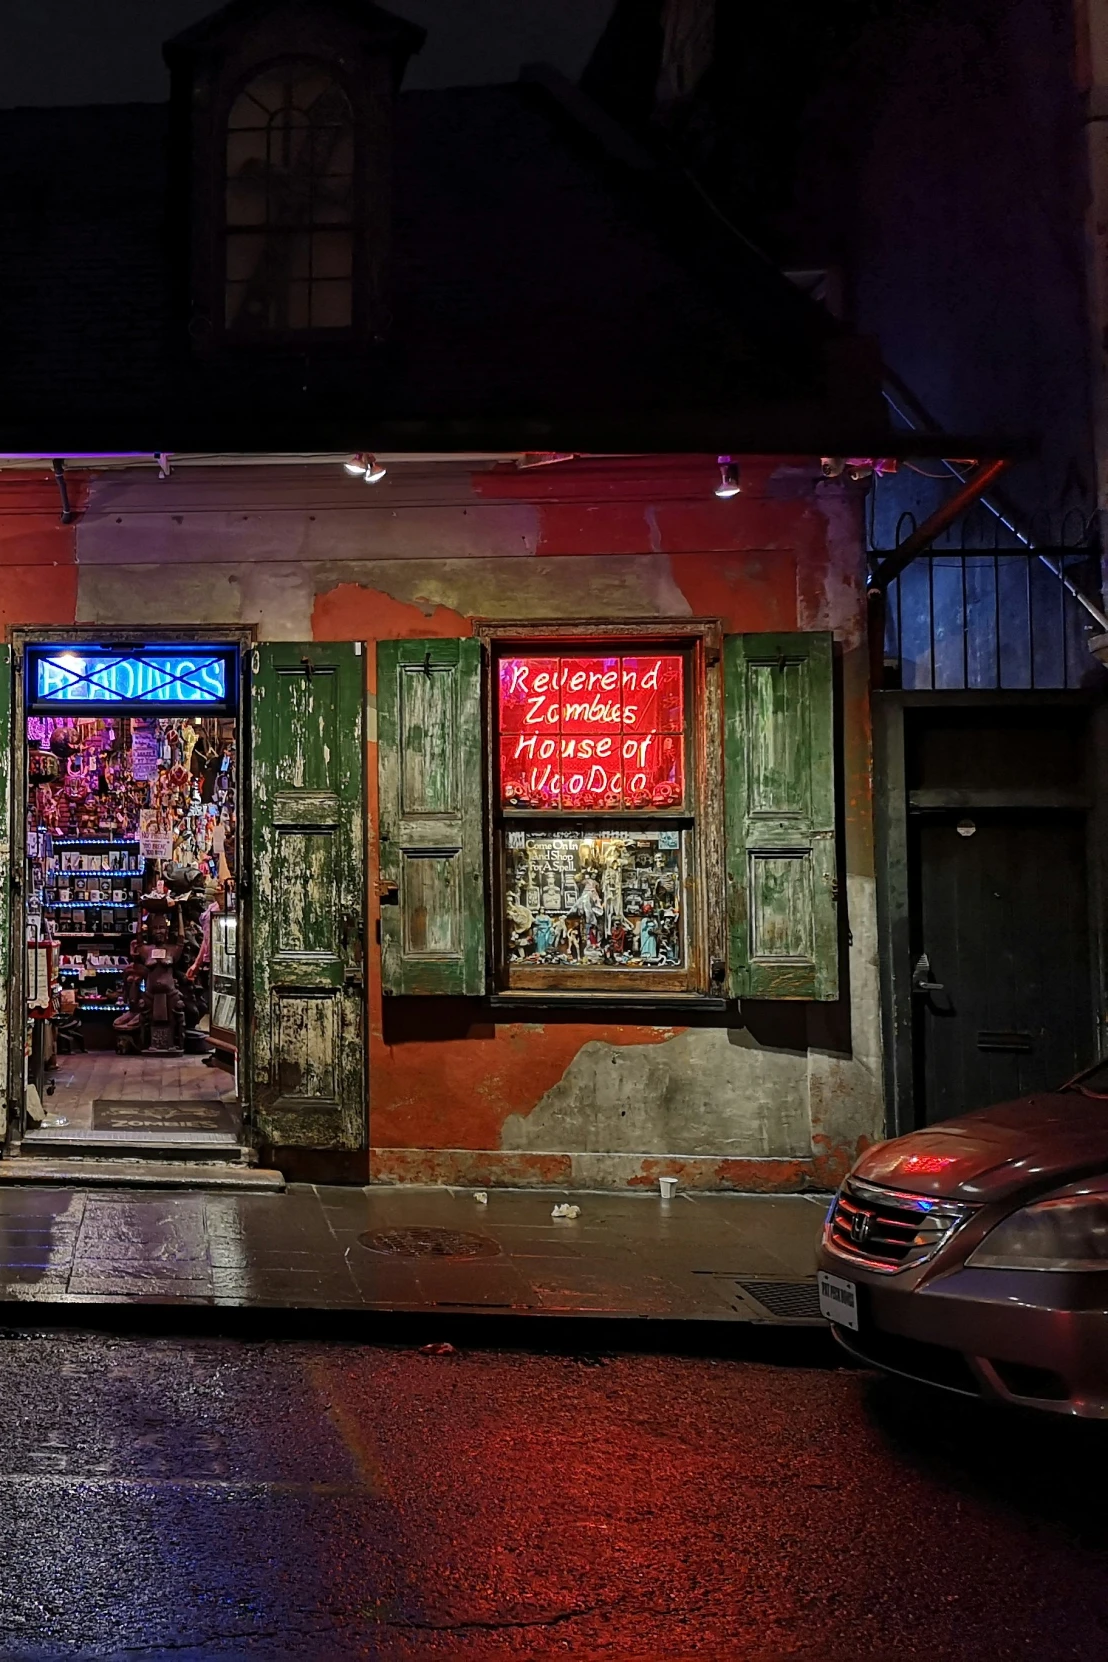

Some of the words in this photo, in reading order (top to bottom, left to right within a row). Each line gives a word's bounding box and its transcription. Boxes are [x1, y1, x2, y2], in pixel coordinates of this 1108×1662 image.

[44, 660, 224, 700] READINGS
[509, 660, 662, 693] Reverend
[514, 731, 612, 759] House
[622, 728, 657, 768] of
[525, 839, 552, 850] Come
[552, 839, 569, 850] On
[568, 839, 579, 851] In
[550, 850, 574, 862] Shop
[543, 860, 553, 871] A
